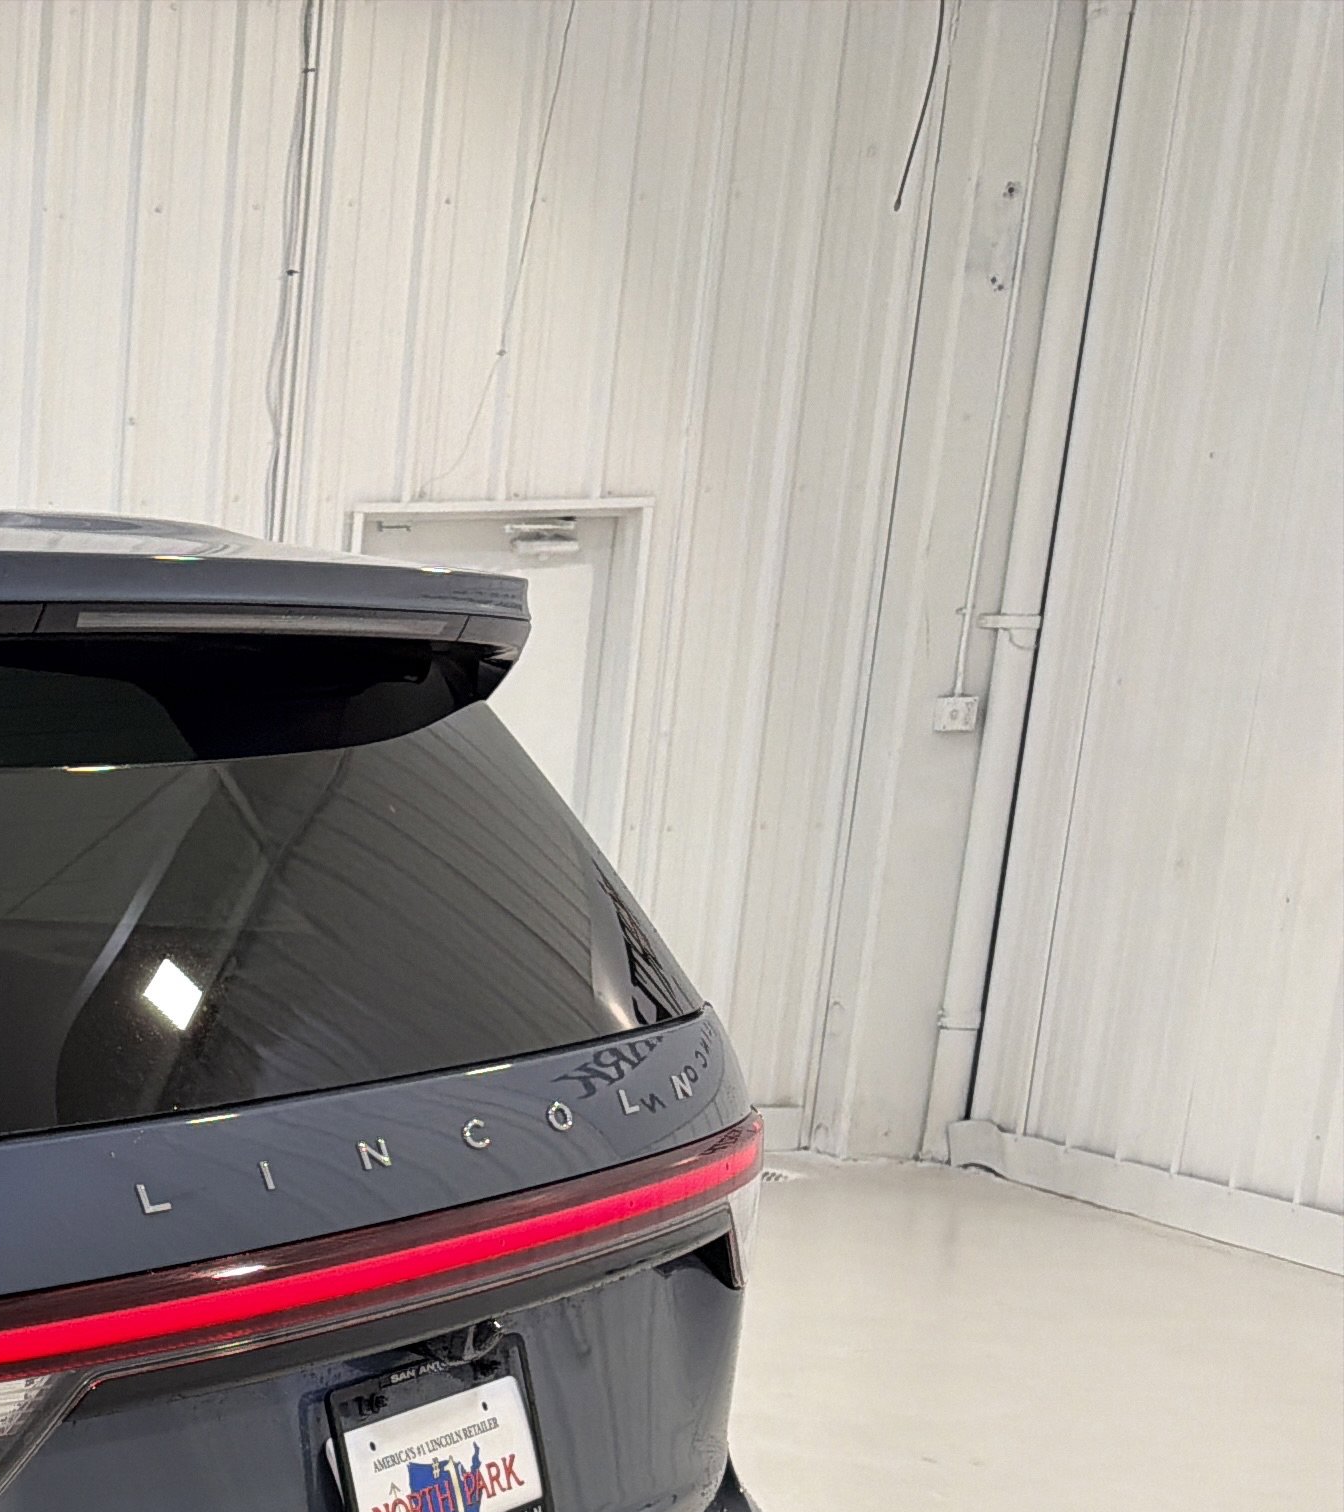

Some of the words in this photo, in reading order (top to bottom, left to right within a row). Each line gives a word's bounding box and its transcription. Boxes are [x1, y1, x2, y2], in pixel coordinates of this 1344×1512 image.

[134, 1073, 694, 1215] LINCOLN
[390, 1369, 416, 1384] SAN
[373, 1446, 417, 1473] AMERICA'S
[426, 1430, 463, 1453] LINCOLN
[462, 1416, 499, 1440] RETAILER
[462, 1453, 525, 1506] PARK
